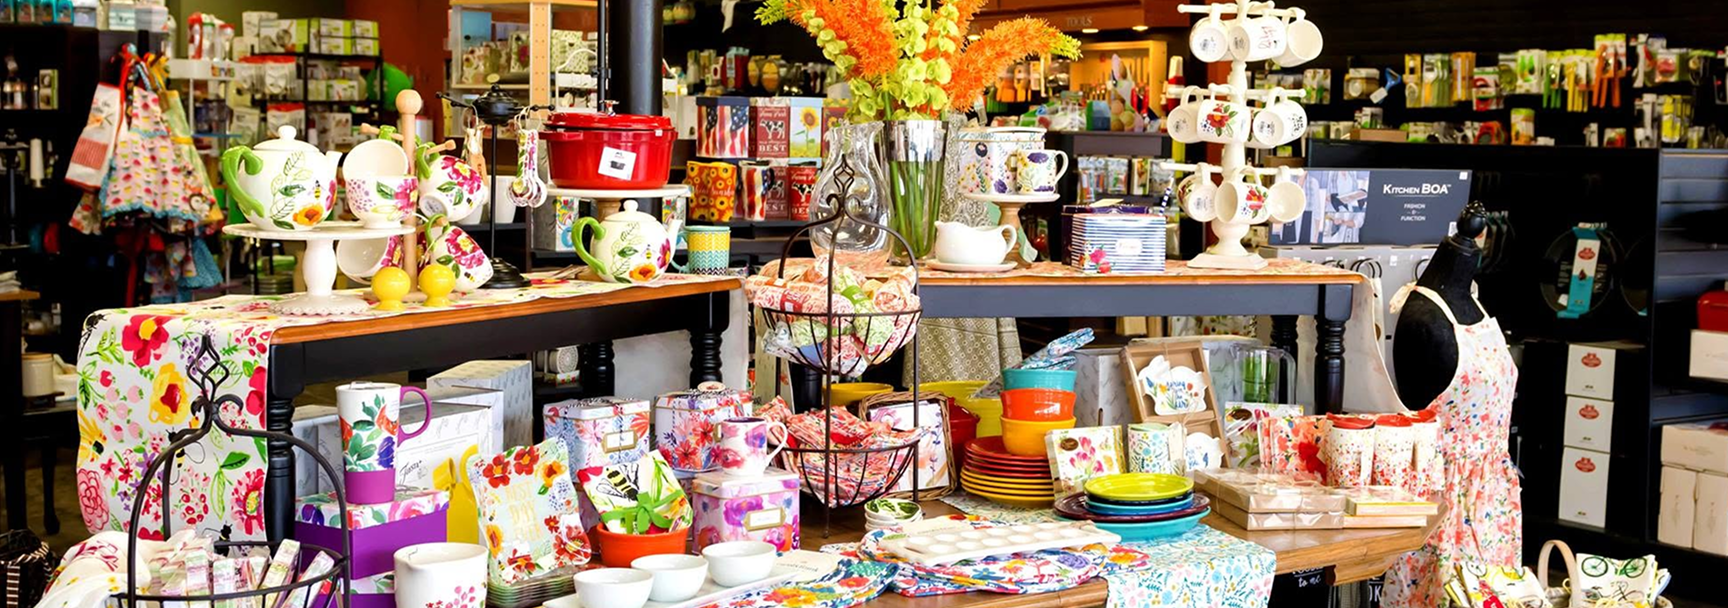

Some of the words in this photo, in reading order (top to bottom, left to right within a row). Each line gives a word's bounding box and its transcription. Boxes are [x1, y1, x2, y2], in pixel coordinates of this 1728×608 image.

[1066, 16, 1092, 27] TOOLS
[759, 144, 787, 152] BEST
[1383, 184, 1420, 194] KITCHEN
